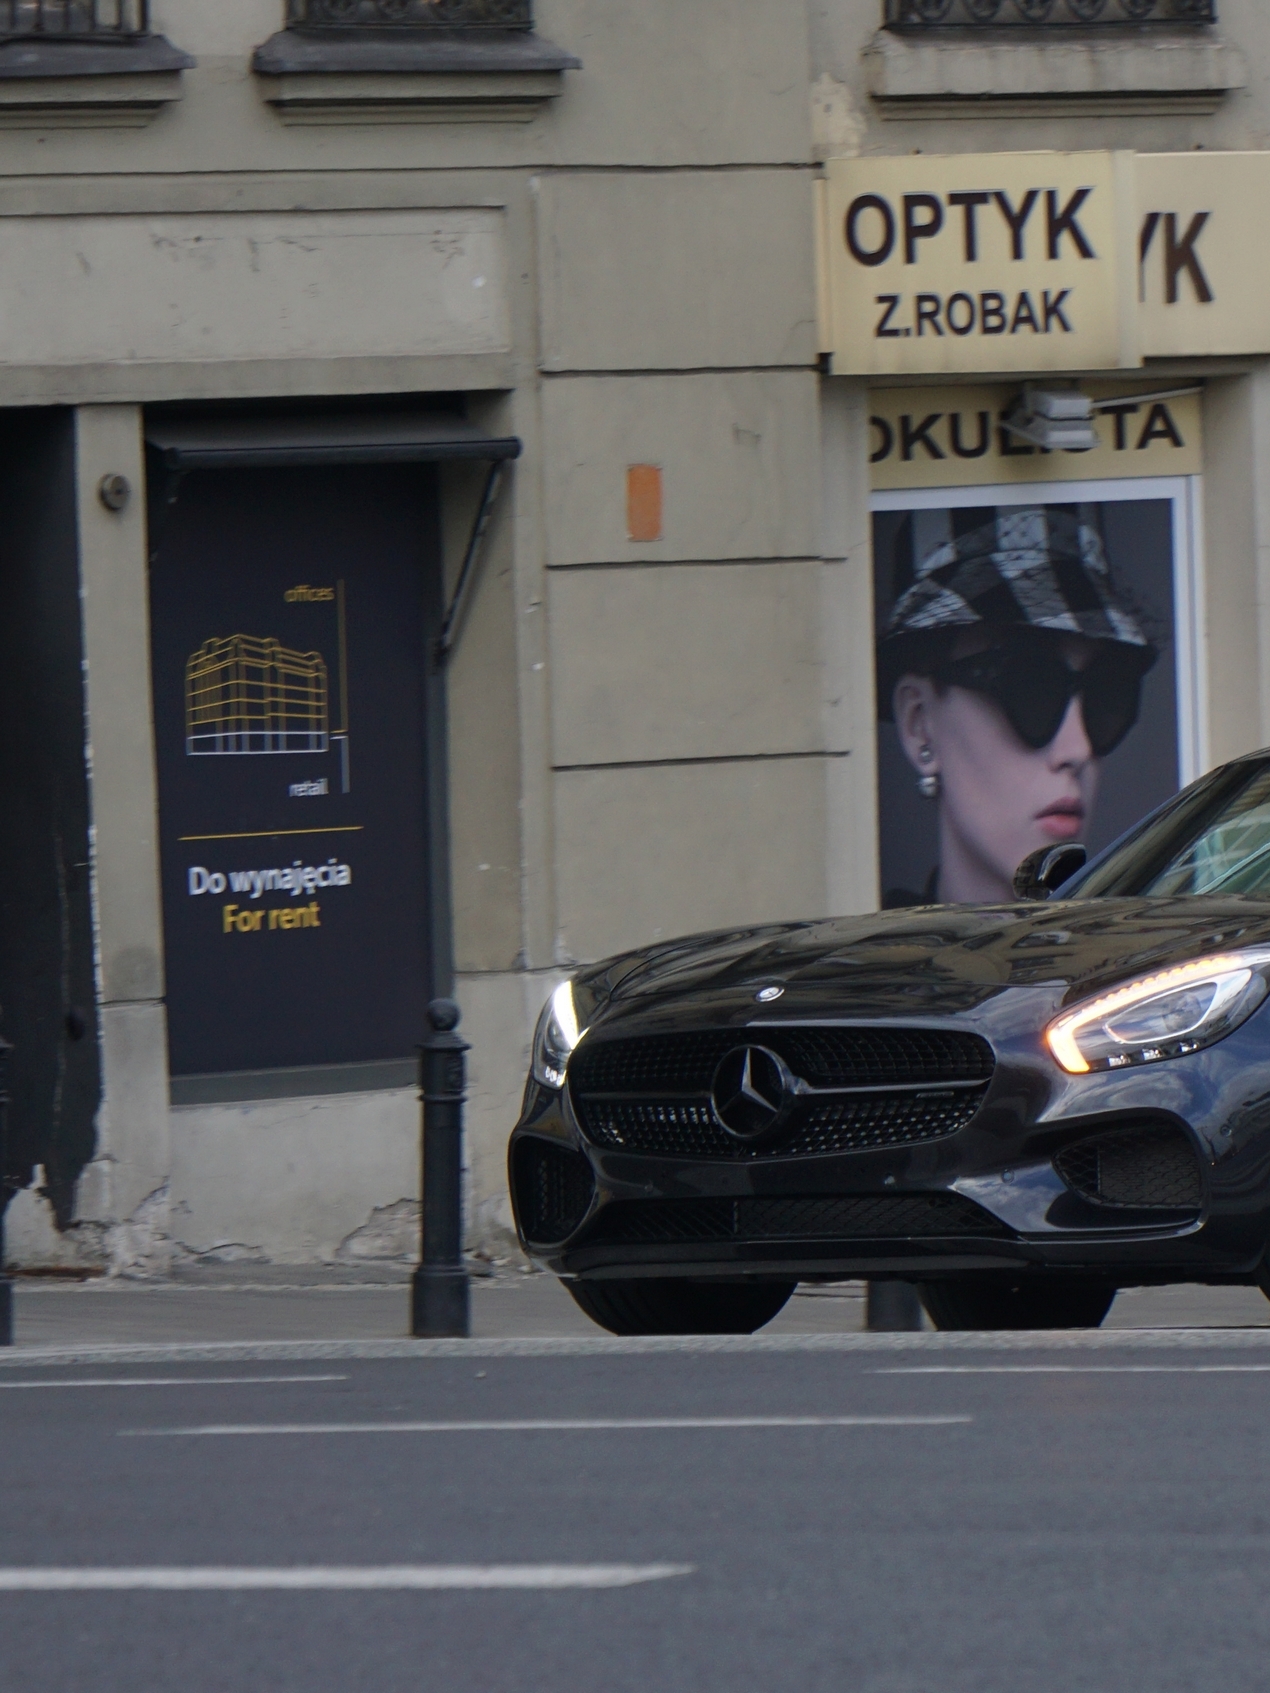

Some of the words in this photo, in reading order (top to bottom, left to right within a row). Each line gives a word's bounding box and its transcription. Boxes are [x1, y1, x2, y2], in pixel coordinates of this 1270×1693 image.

[844, 186, 1096, 268] OPTYK
[875, 288, 1073, 338] Z.ROBAK
[283, 584, 336, 603] offices
[289, 777, 329, 797] retail
[188, 866, 227, 896] Do
[229, 857, 352, 899] wynajęcia
[223, 904, 266, 934] For
[269, 901, 321, 931] rent
